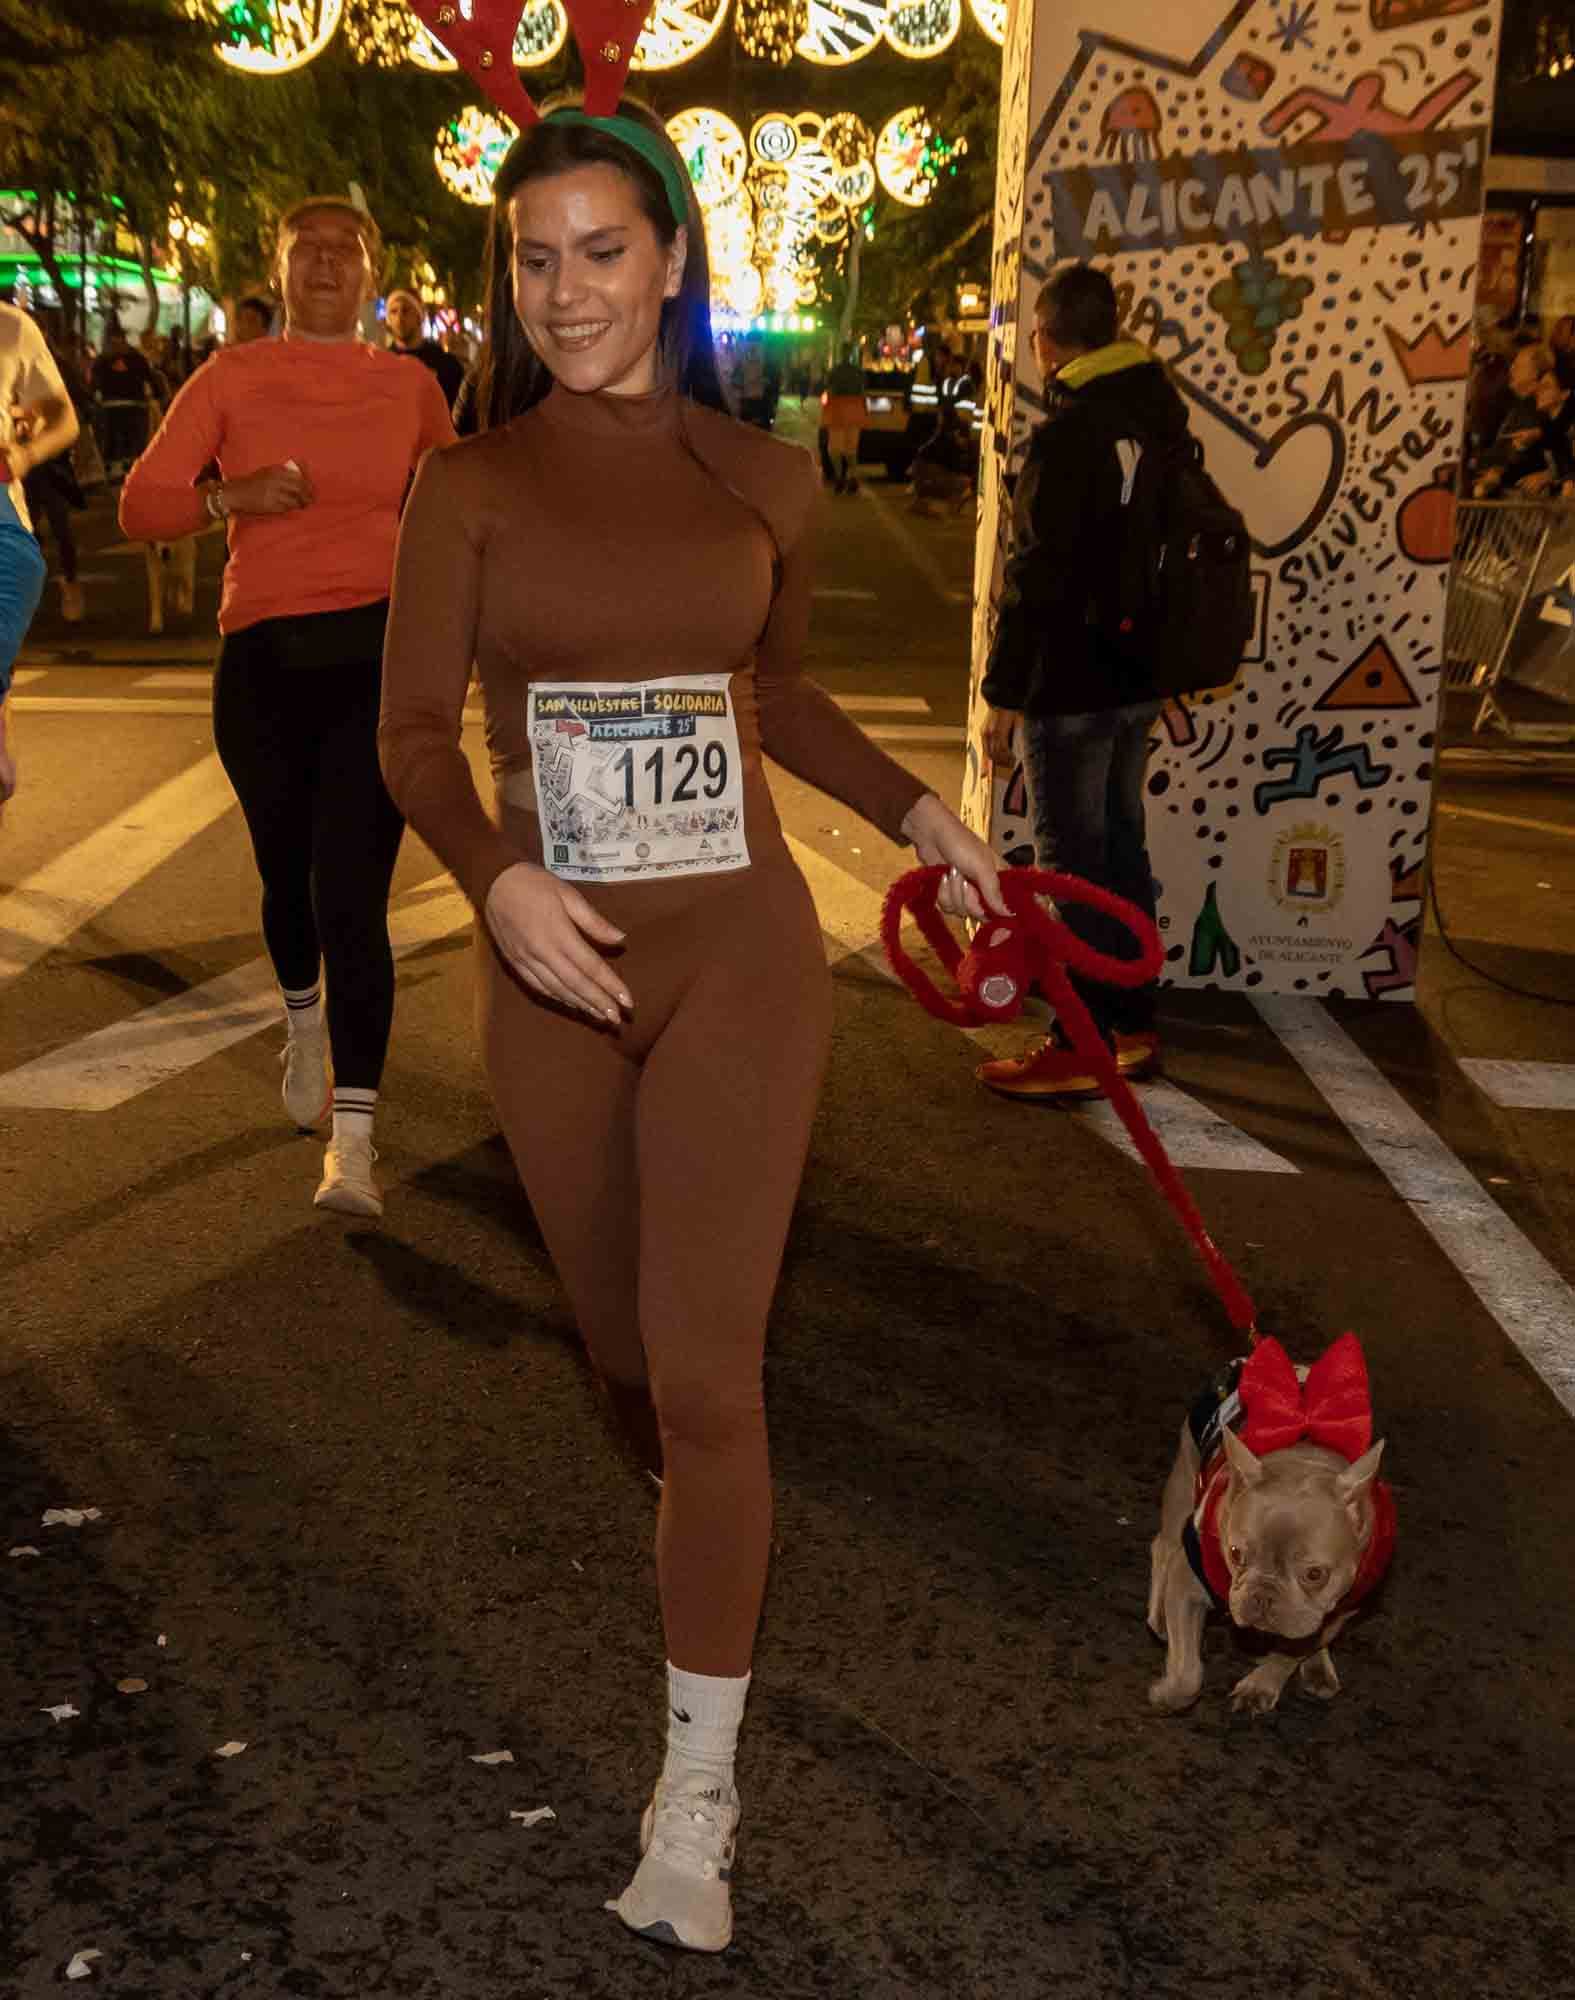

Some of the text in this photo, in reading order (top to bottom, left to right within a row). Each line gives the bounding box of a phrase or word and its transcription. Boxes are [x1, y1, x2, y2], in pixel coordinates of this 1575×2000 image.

[1083, 137, 1479, 241] ALICANTE 25'
[1283, 366, 1401, 435] SAN
[1279, 405, 1453, 604] SILVESTRE
[537, 693, 725, 713] SAN SILVESTRE SOLIDARIA
[592, 719, 671, 737] ALICANTE
[613, 740, 728, 808] 1129
[1248, 935, 1353, 950] AYUNTAMIENTO
[1258, 951, 1345, 966] DE ALICANTE
